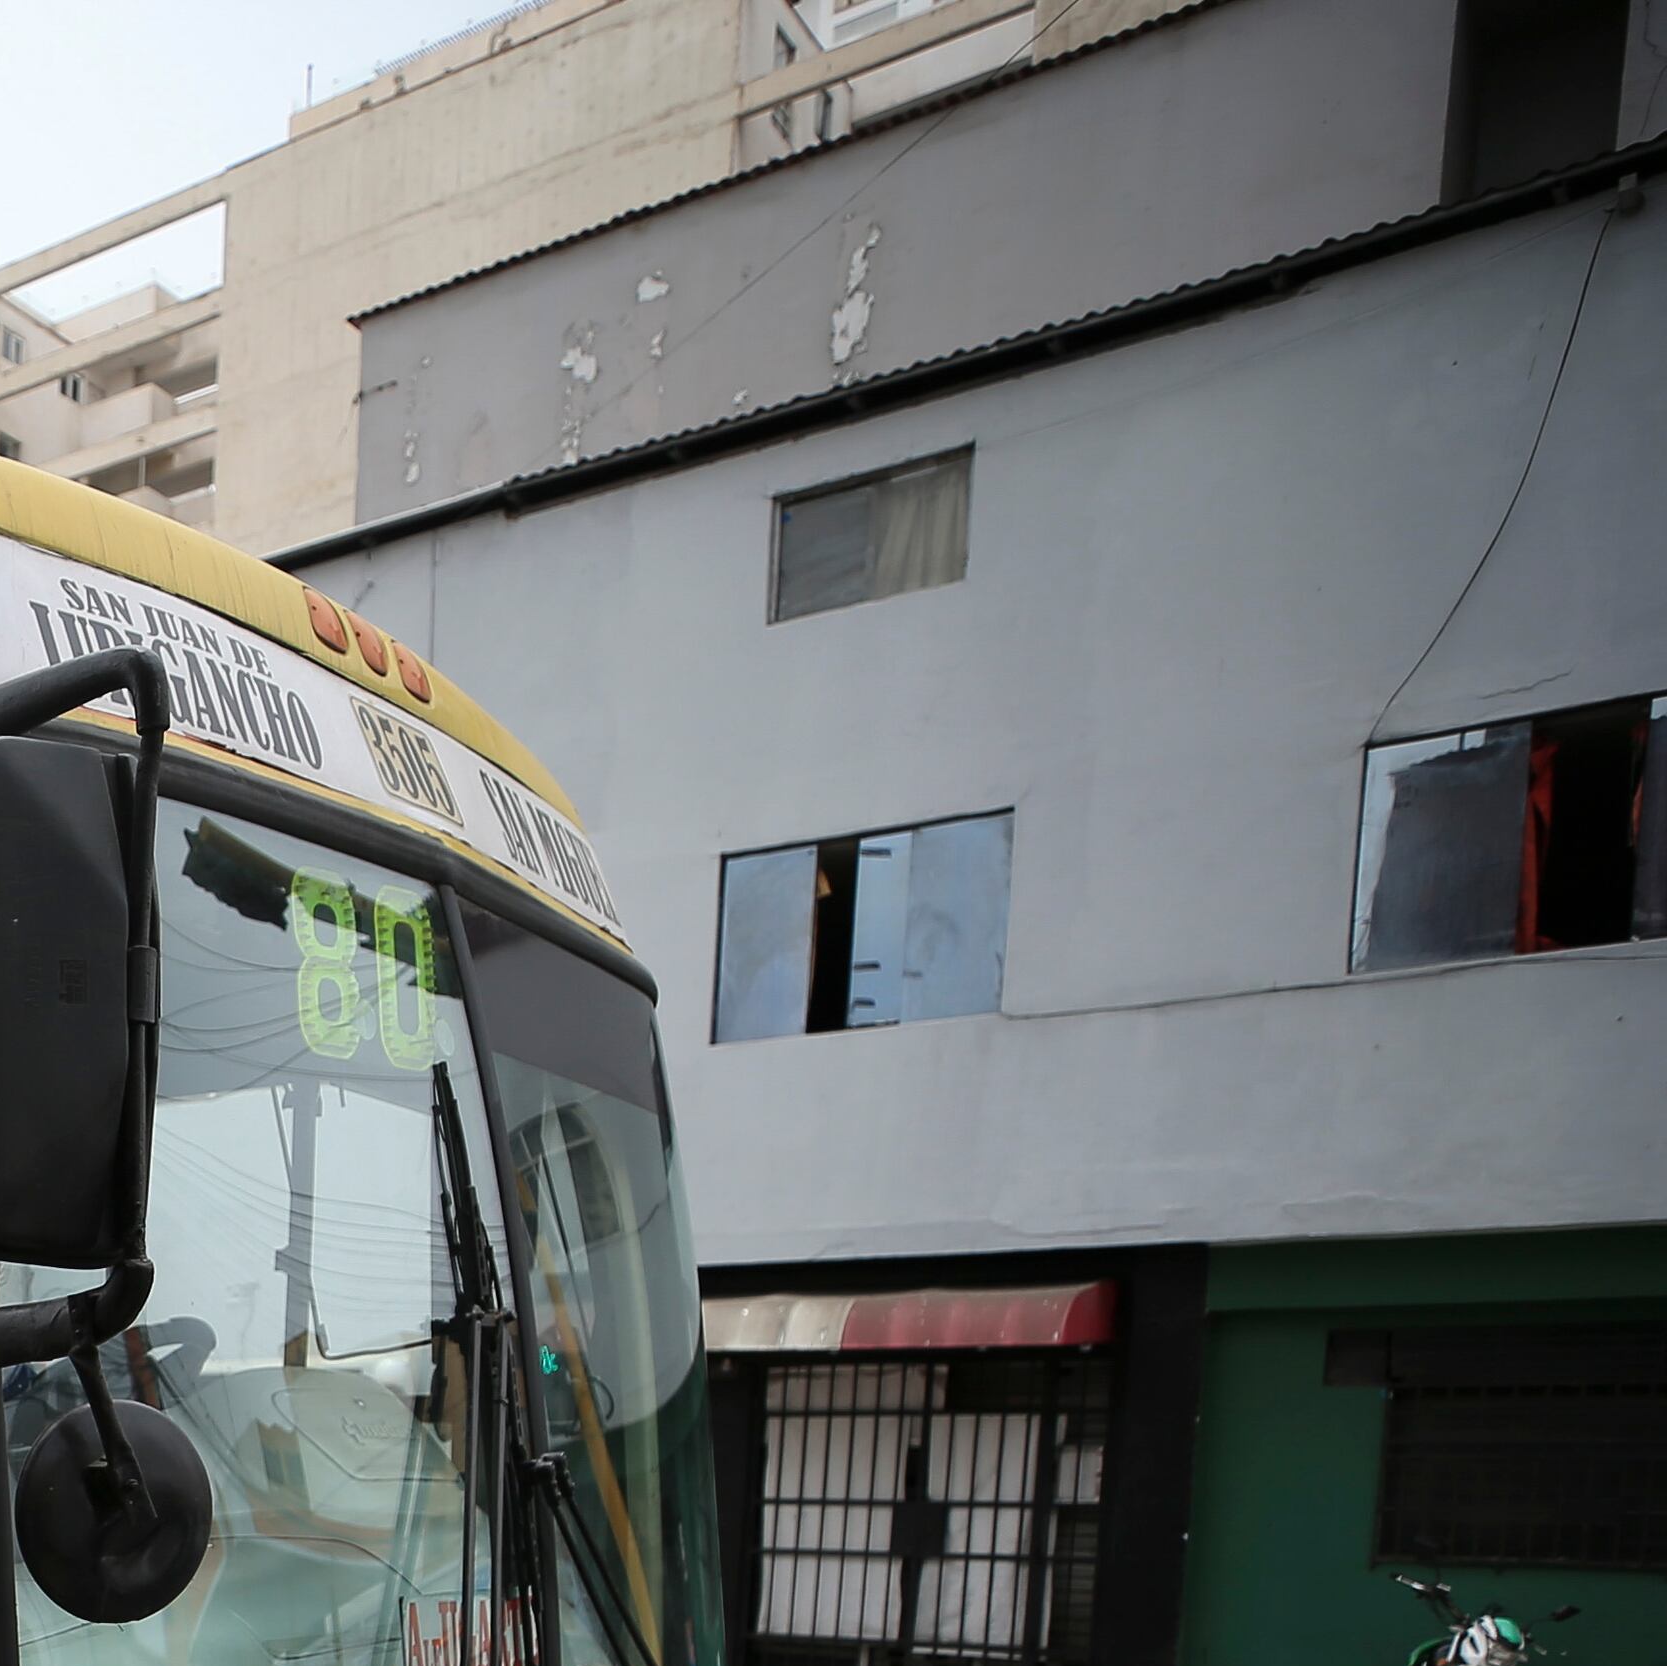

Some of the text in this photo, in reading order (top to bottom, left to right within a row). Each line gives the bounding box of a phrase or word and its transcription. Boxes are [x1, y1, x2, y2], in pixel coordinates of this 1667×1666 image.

[60, 578, 272, 678] SAN JUAN DE
[29, 600, 323, 770] LGANCHO
[358, 706, 455, 816] 3505
[480, 769, 548, 881] SAN
[291, 866, 435, 1072] 80
